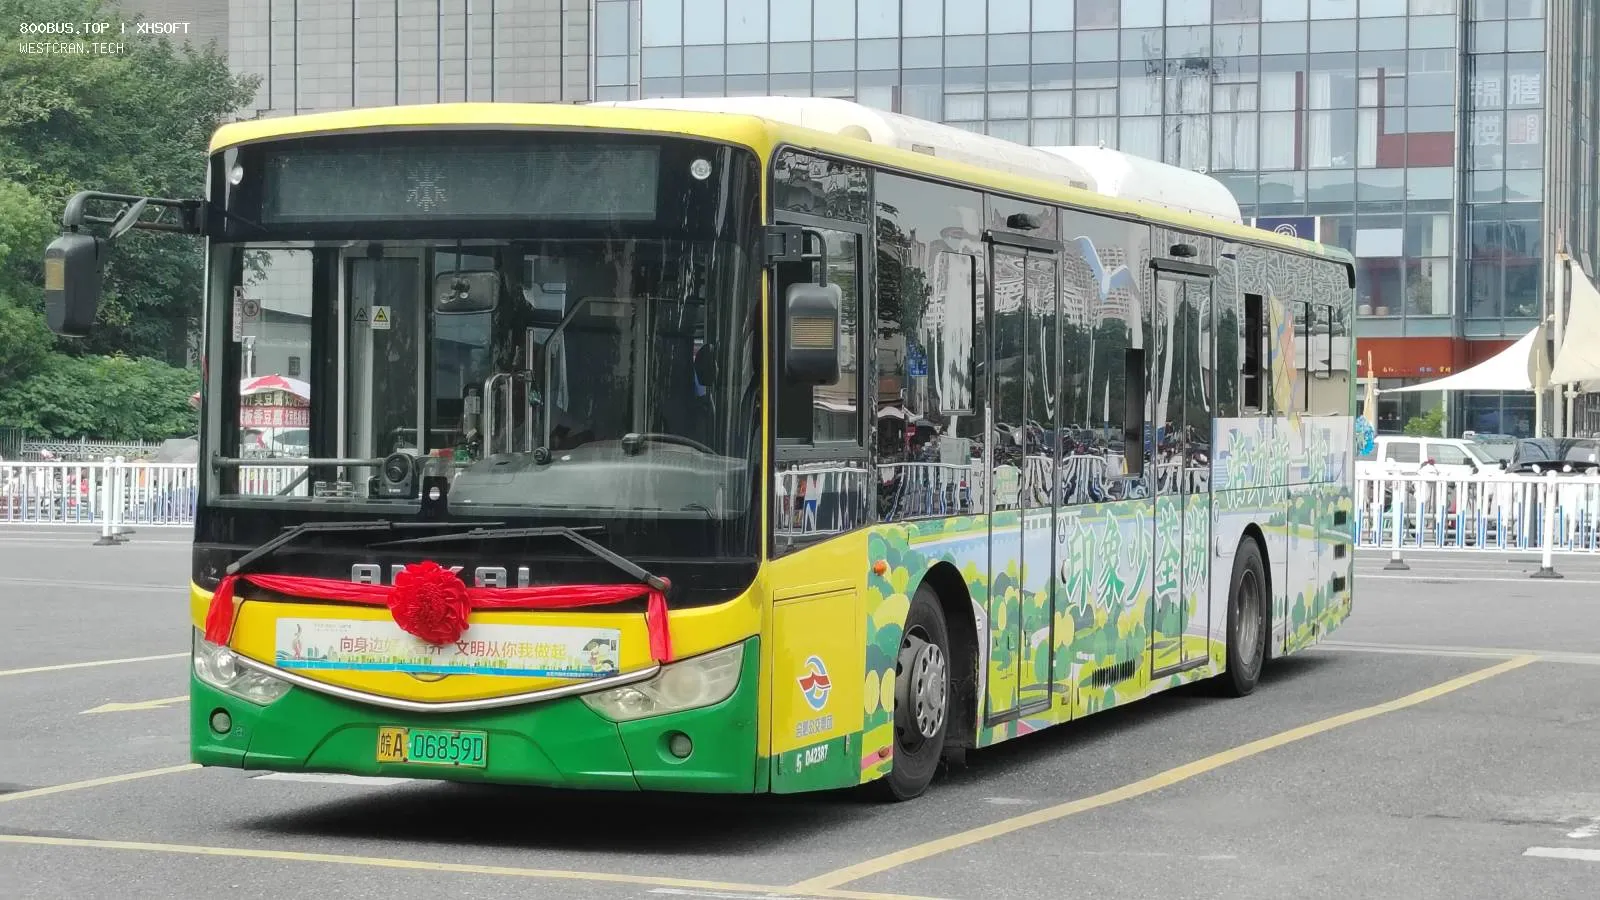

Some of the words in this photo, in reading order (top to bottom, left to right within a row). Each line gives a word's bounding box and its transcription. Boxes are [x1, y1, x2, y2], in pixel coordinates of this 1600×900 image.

[1066, 503, 1209, 616] 印象少荃湖
[455, 640, 567, 659] 文明从你我做起
